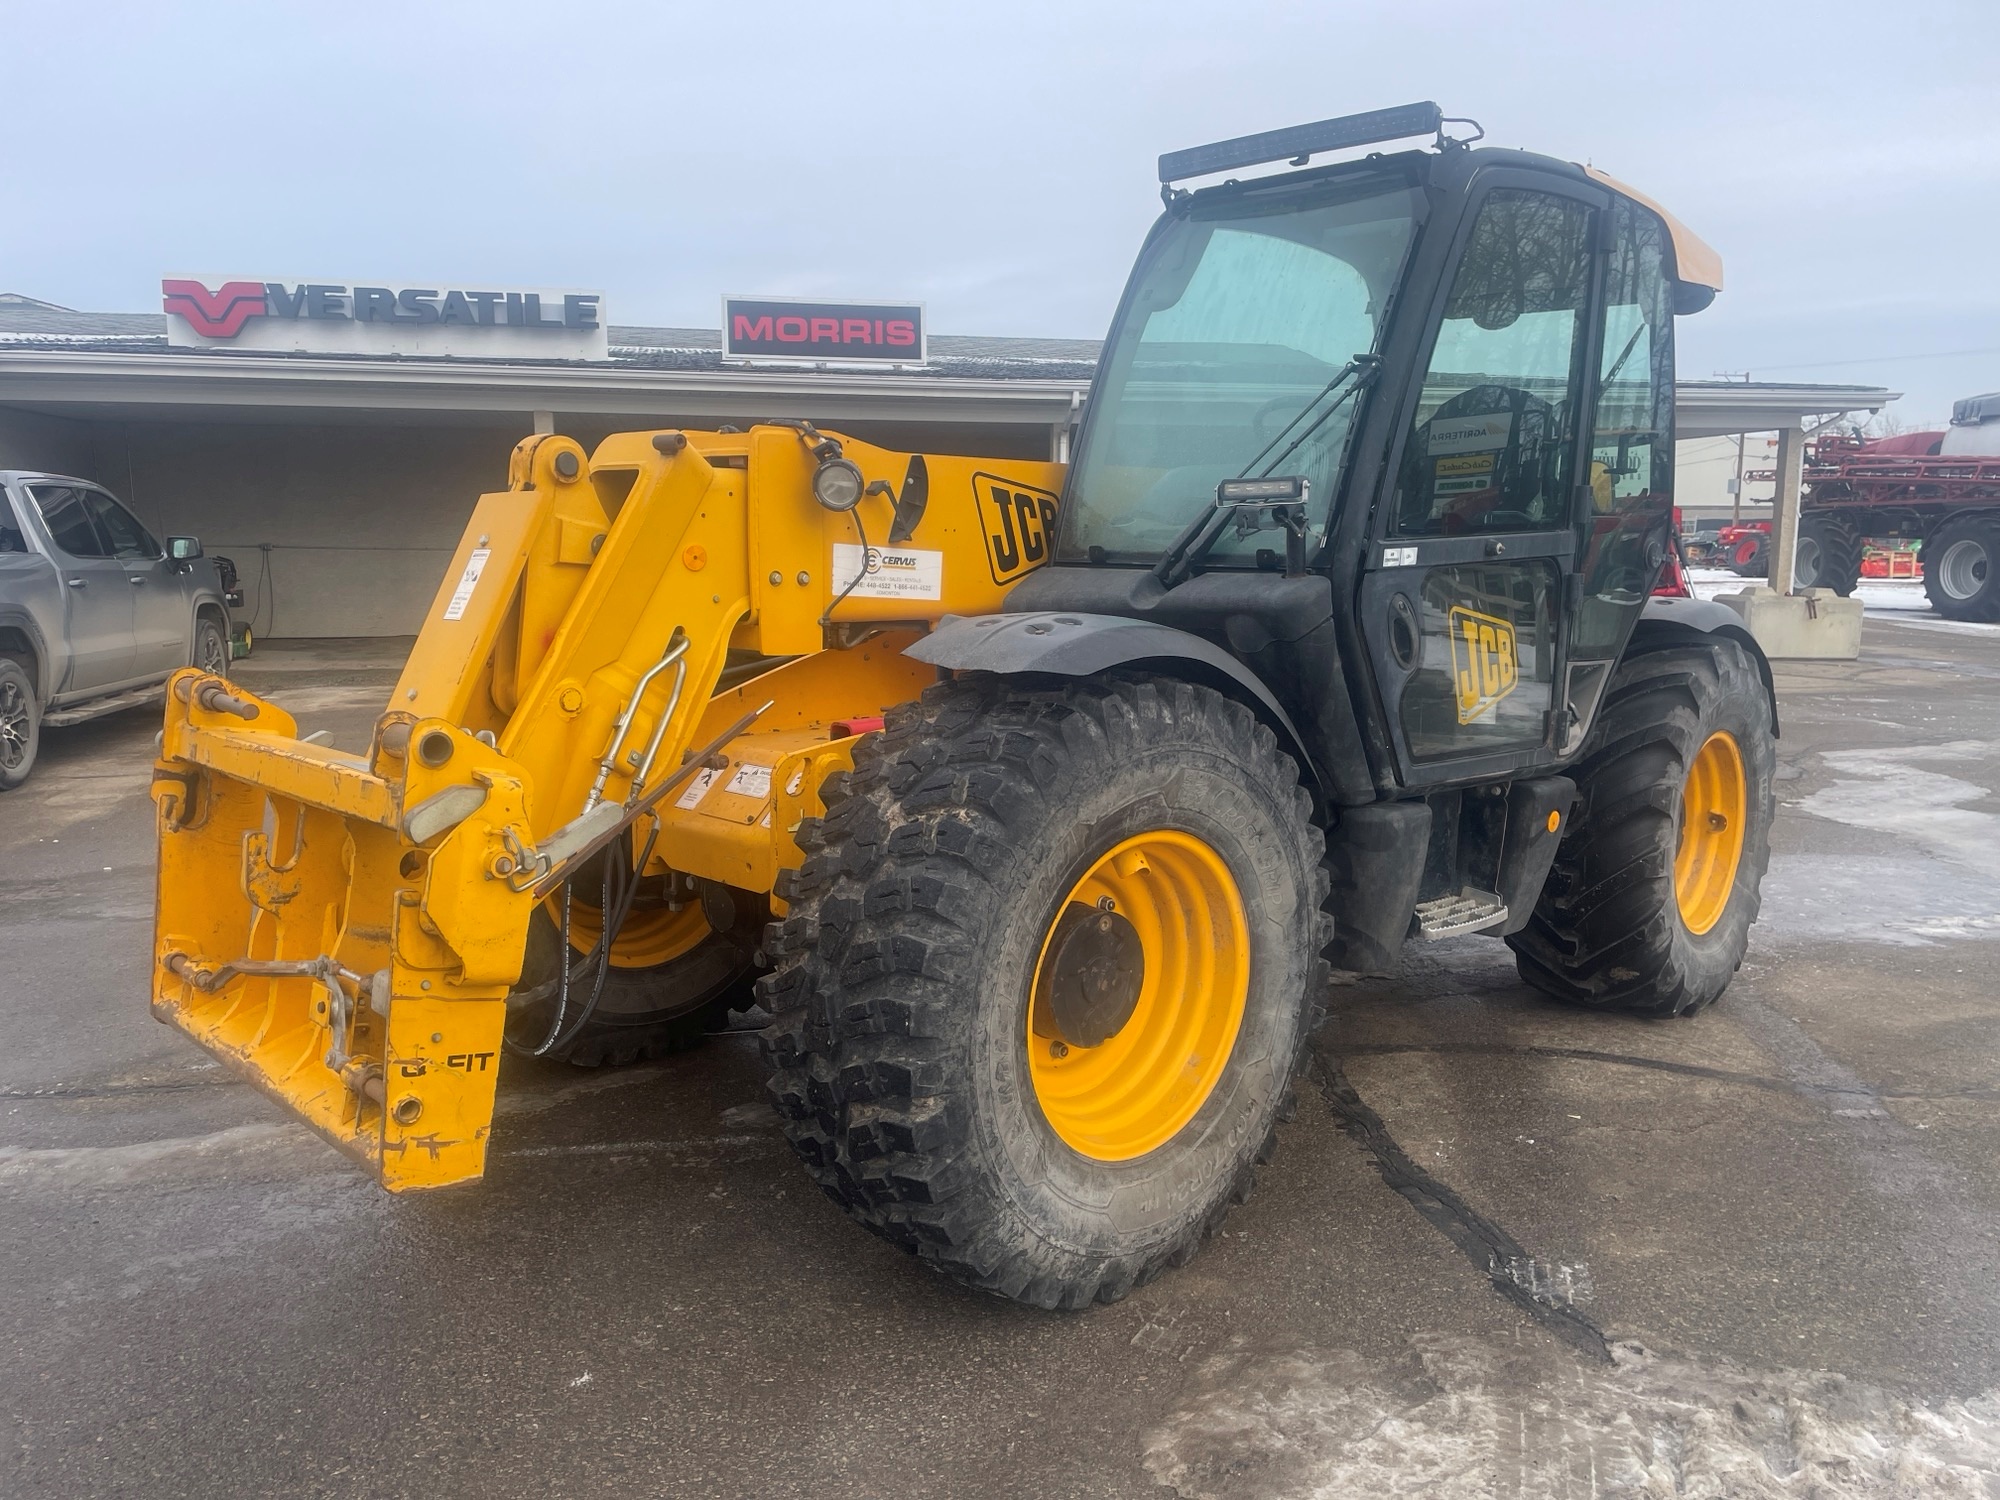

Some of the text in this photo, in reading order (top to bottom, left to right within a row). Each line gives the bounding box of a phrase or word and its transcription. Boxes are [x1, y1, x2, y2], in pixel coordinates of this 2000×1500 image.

[266, 282, 600, 330] VERSATILE
[734, 315, 916, 346] MORRIS
[881, 556, 917, 566] CERVUS
[1460, 619, 1514, 710] JCB
